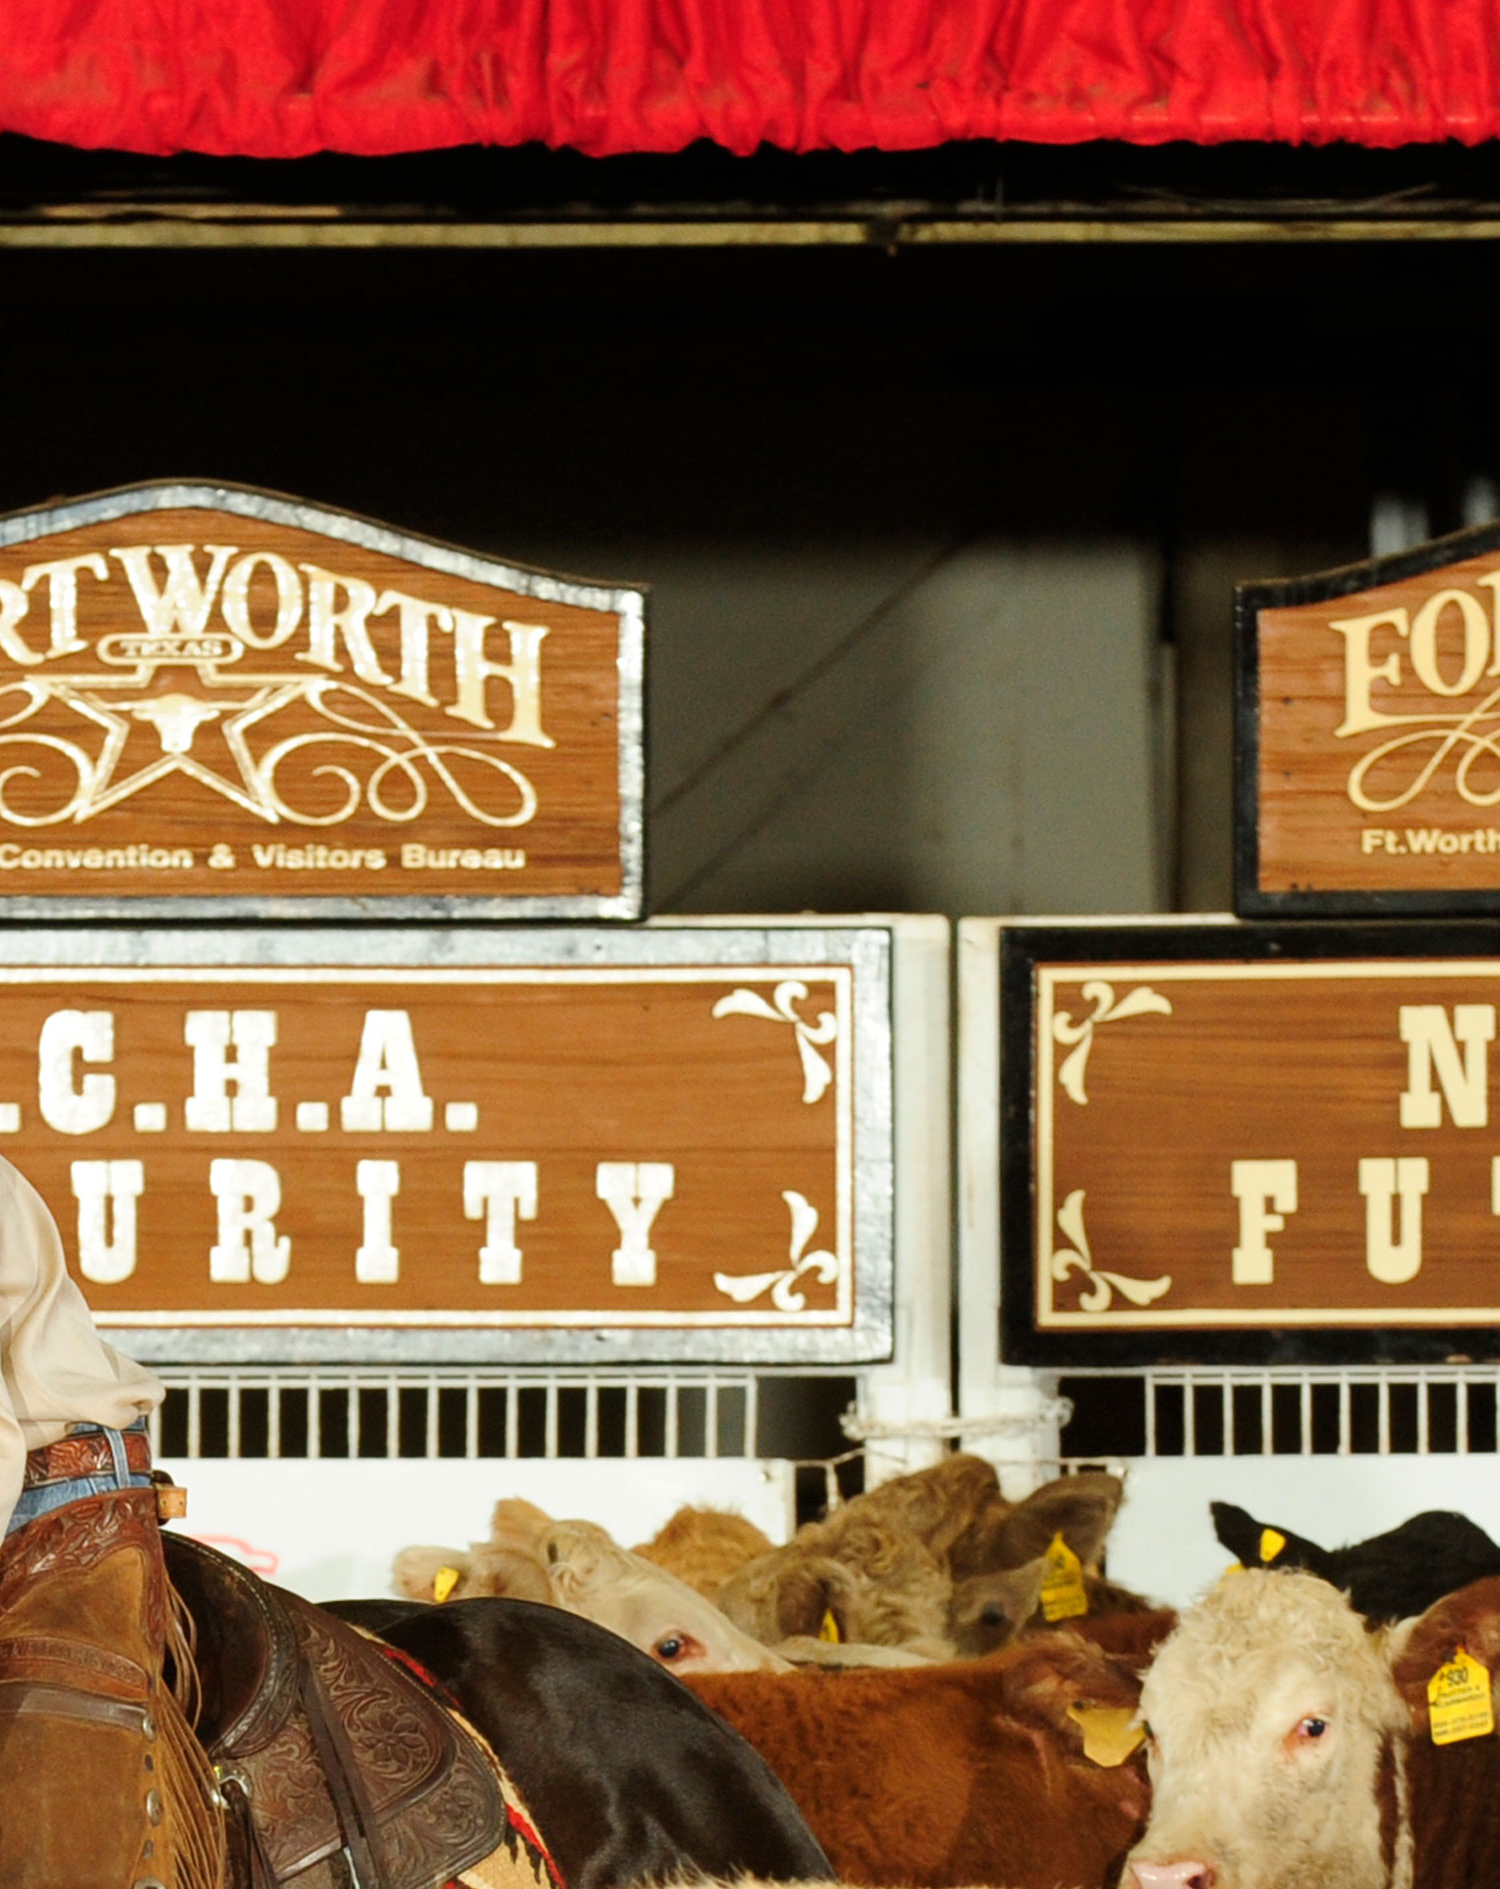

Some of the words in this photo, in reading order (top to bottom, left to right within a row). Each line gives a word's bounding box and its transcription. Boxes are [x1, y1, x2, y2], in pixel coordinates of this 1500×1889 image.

[109, 544, 555, 748] WORTH
[119, 639, 223, 658] TEXAS
[1329, 569, 1500, 738] FO
[208, 844, 236, 870] &
[252, 844, 388, 870] Visitors
[401, 844, 527, 870] Bureau
[71, 1159, 676, 1288] URITY
[1231, 1156, 1500, 1285] FU
